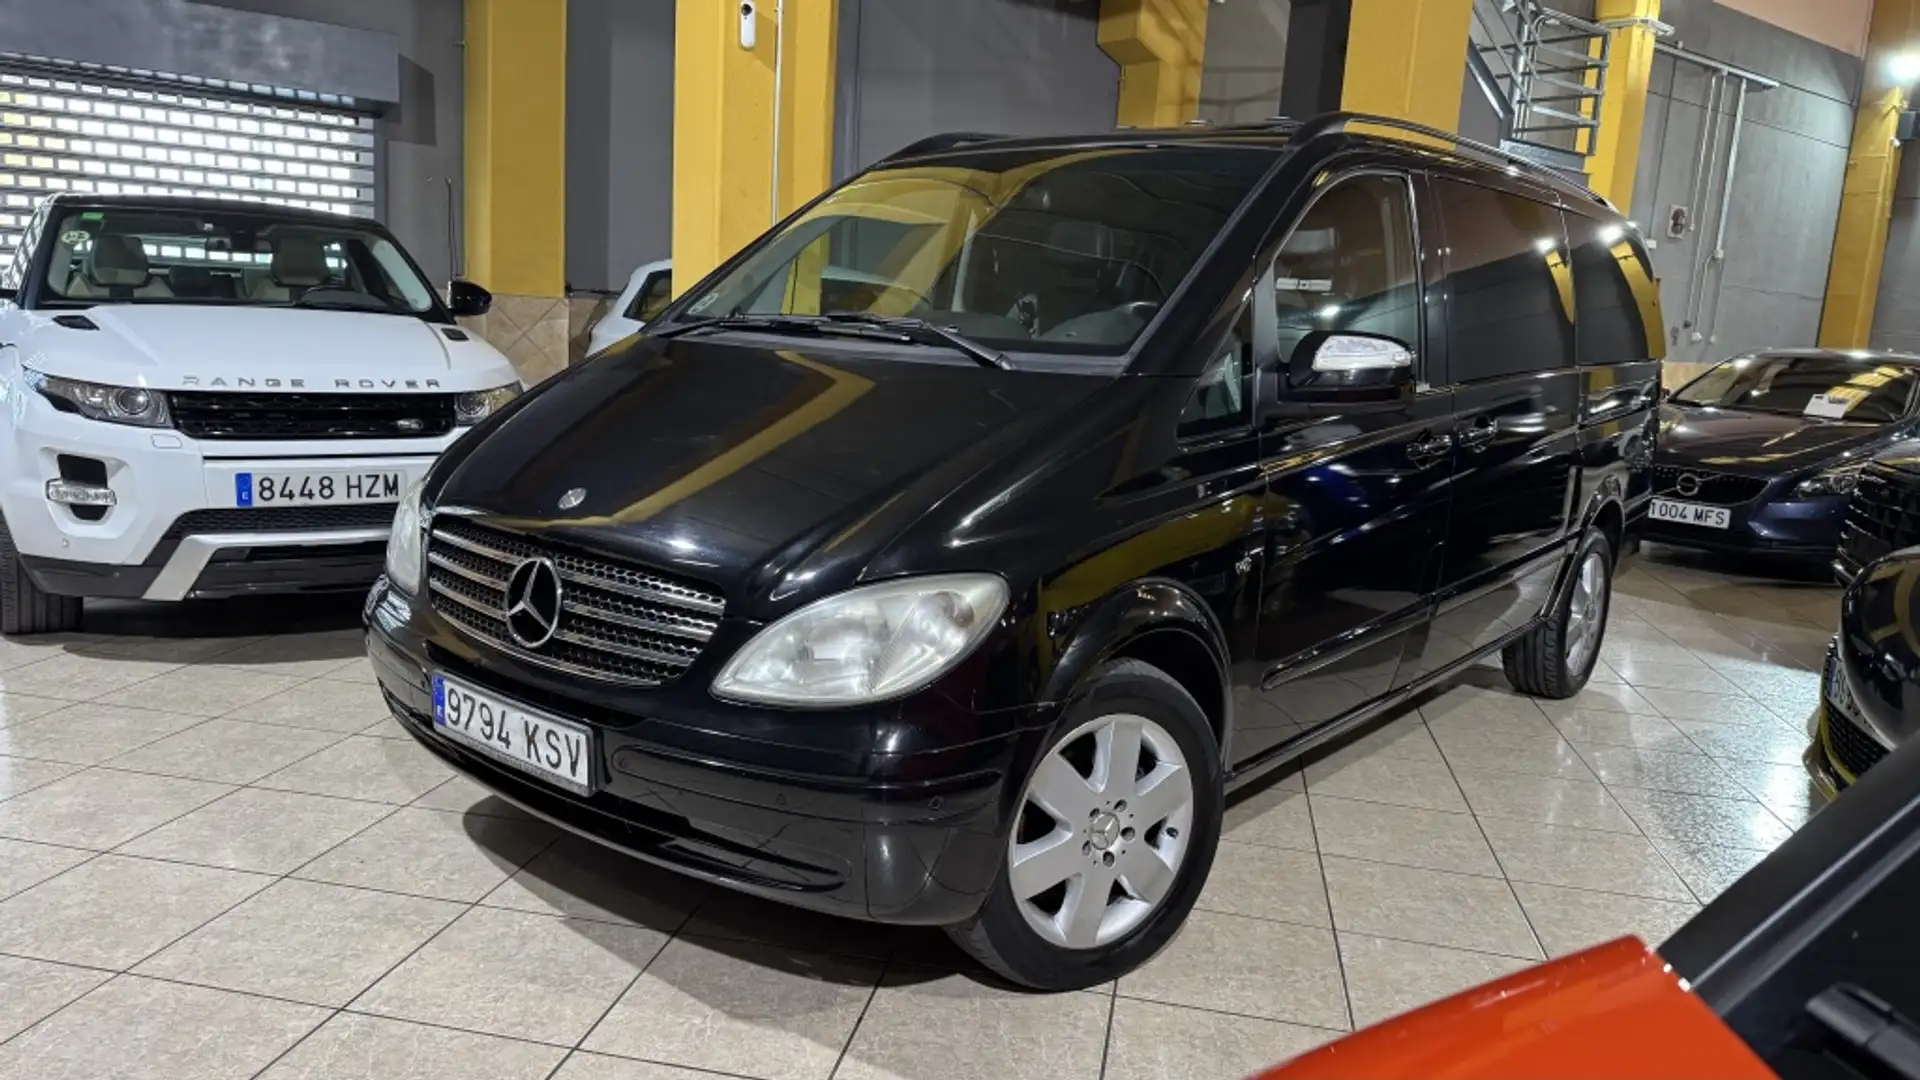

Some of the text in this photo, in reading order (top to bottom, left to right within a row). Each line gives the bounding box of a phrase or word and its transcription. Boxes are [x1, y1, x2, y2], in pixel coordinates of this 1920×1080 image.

[182, 375, 442, 389] RANGE ROVER
[258, 473, 399, 501] 8448 HZM
[1693, 507, 1725, 525] MFS
[447, 688, 581, 778] 9794 KSV
